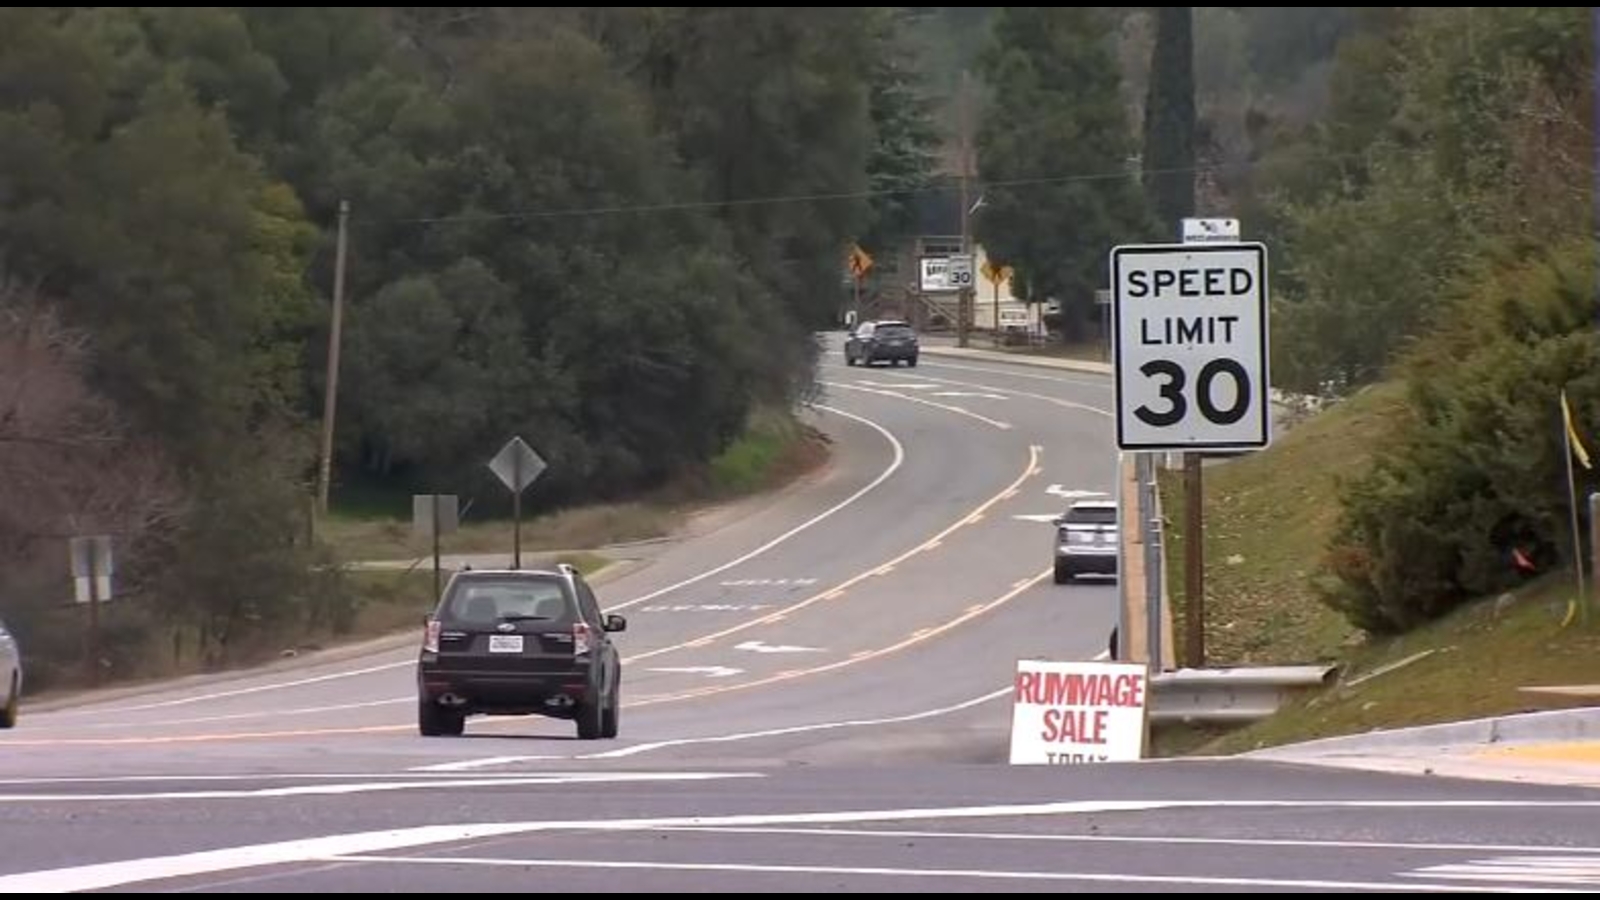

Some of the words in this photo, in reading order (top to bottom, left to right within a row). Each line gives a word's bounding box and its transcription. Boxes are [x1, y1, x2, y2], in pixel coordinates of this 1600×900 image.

[951, 271, 971, 284] 30
[1128, 268, 1252, 297] SPEED
[1141, 316, 1239, 345] LIMIT
[1133, 357, 1252, 428] 30
[1016, 671, 1143, 707] RUMMAGE
[1041, 708, 1109, 745] SALE
